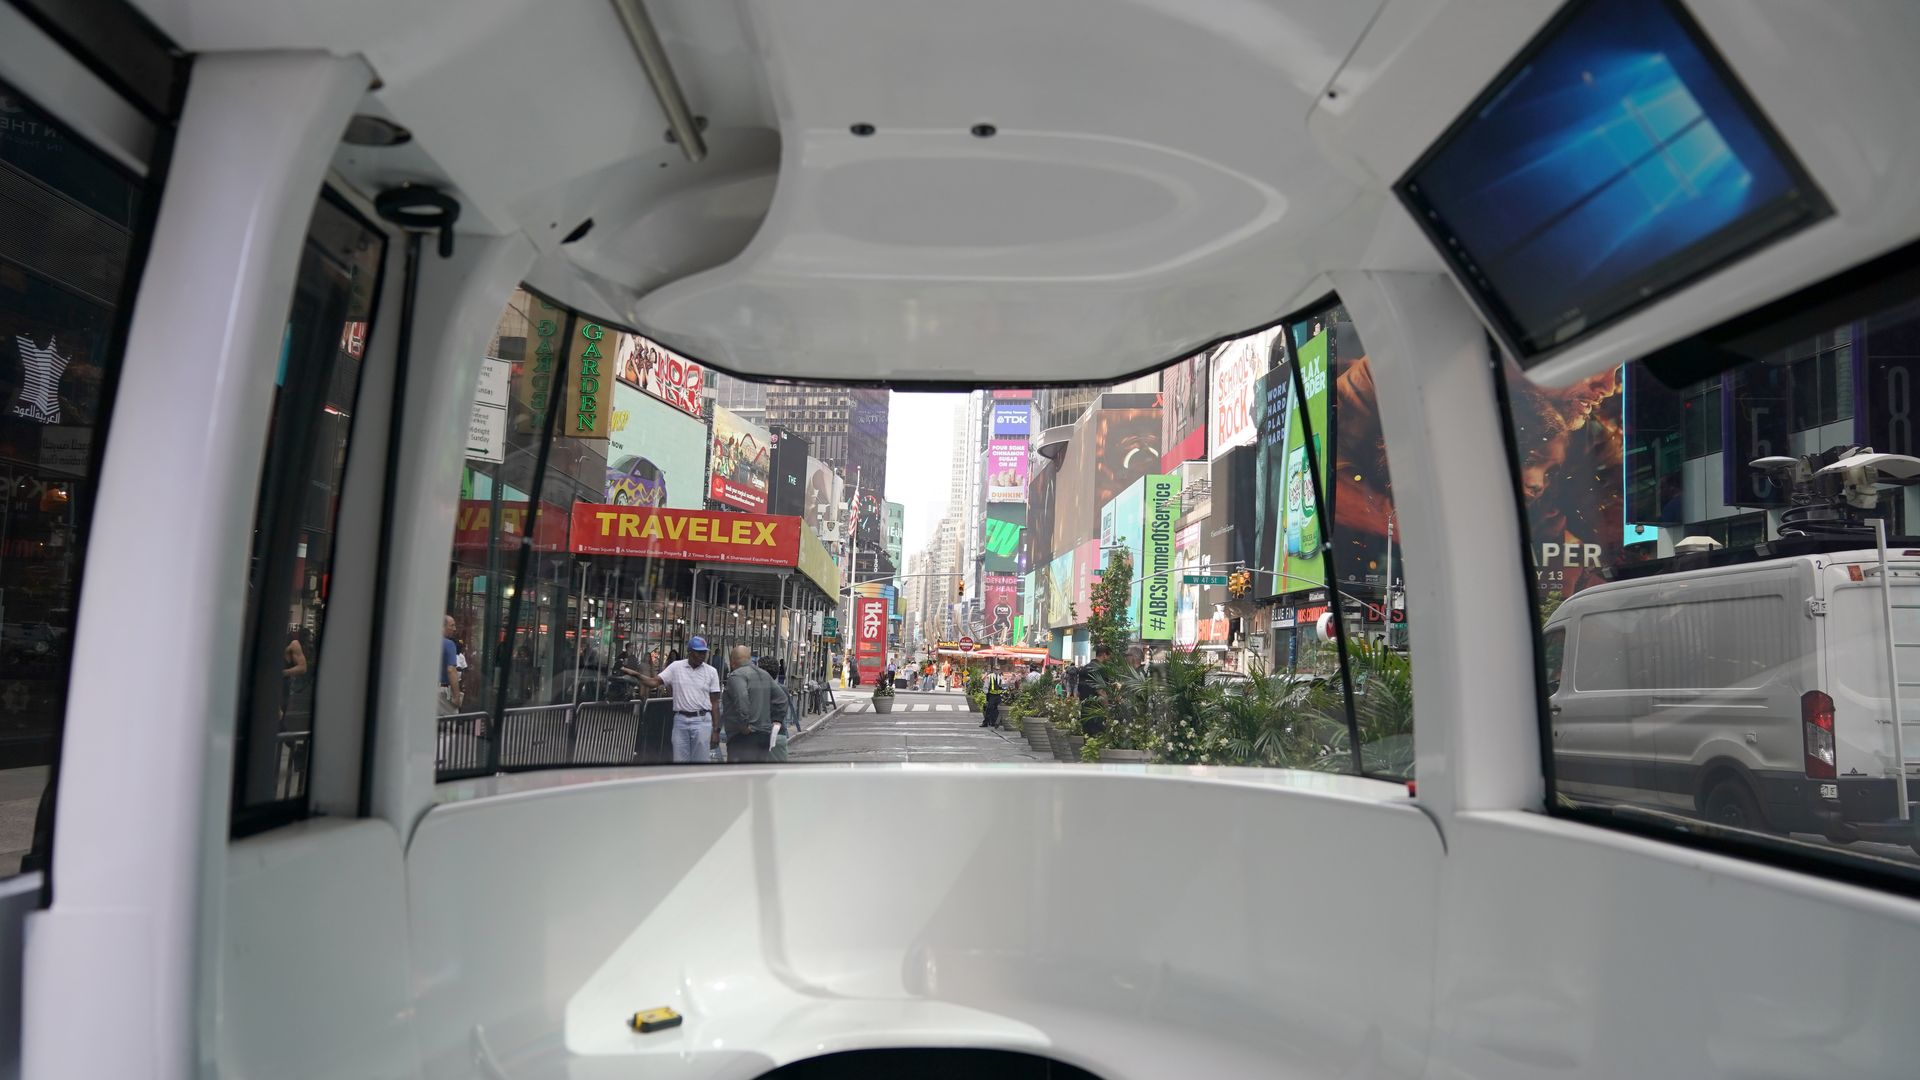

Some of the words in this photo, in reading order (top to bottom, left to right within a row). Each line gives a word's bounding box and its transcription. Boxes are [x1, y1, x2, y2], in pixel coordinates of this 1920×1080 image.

[576, 322, 604, 433] GARDEN
[1219, 349, 1248, 402] SCHOOL
[1267, 382, 1287, 402] WORK
[1219, 384, 1248, 447] ROCK
[1267, 398, 1286, 416] HARD
[1004, 416, 1028, 424] TDK
[1267, 412, 1286, 431] PLAY
[1267, 428, 1286, 445] HARD
[788, 474, 797, 486] THE
[595, 512, 778, 547] TRAVELEX
[1149, 482, 1171, 632] #ABCSummerOfService
[1815, 560, 1823, 570] 2
[1192, 576, 1200, 584] W
[1201, 576, 1209, 584] 47
[1210, 576, 1217, 585] St
[1548, 571, 1564, 580] 13
[863, 602, 883, 639] tkts
[1271, 608, 1285, 621] BLUE
[1285, 607, 1295, 619] FIN
